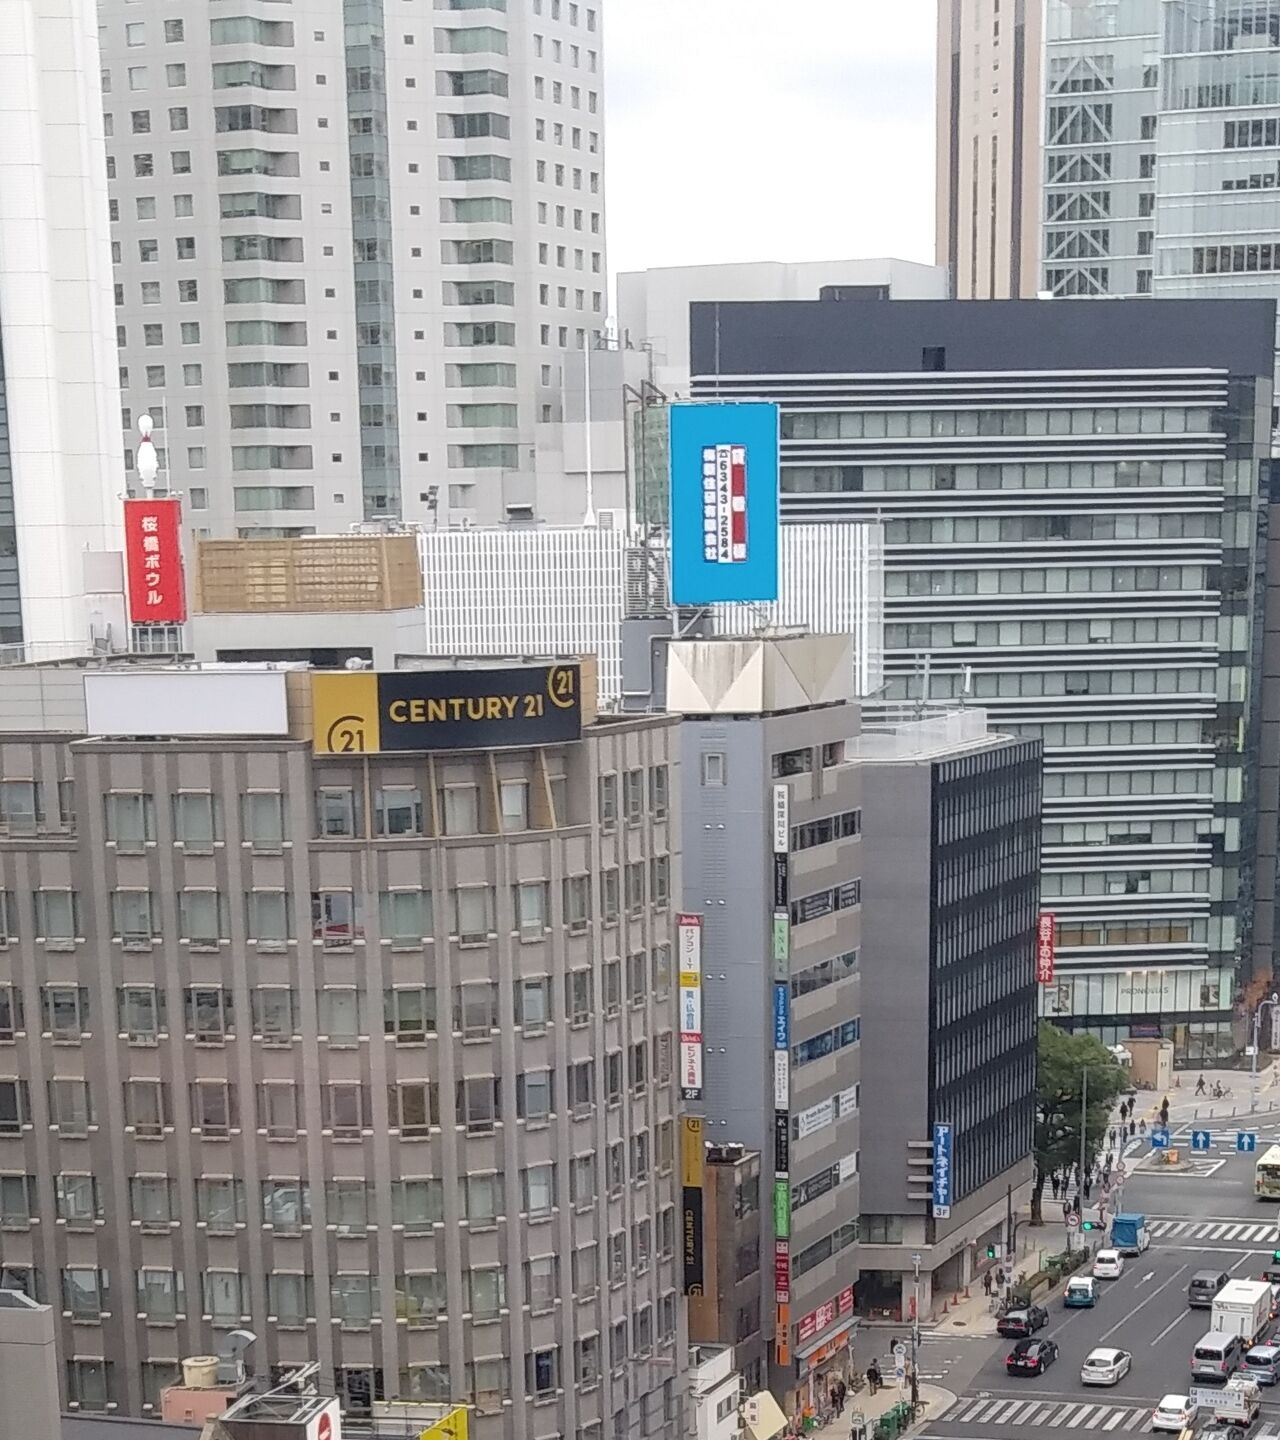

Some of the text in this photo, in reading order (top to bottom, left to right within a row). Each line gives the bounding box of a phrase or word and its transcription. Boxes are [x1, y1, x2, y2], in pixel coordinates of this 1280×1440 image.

[141, 516, 163, 605] 桜橋ボウル
[389, 694, 543, 722] CENTURY 21
[685, 1089, 698, 1099] 2F
